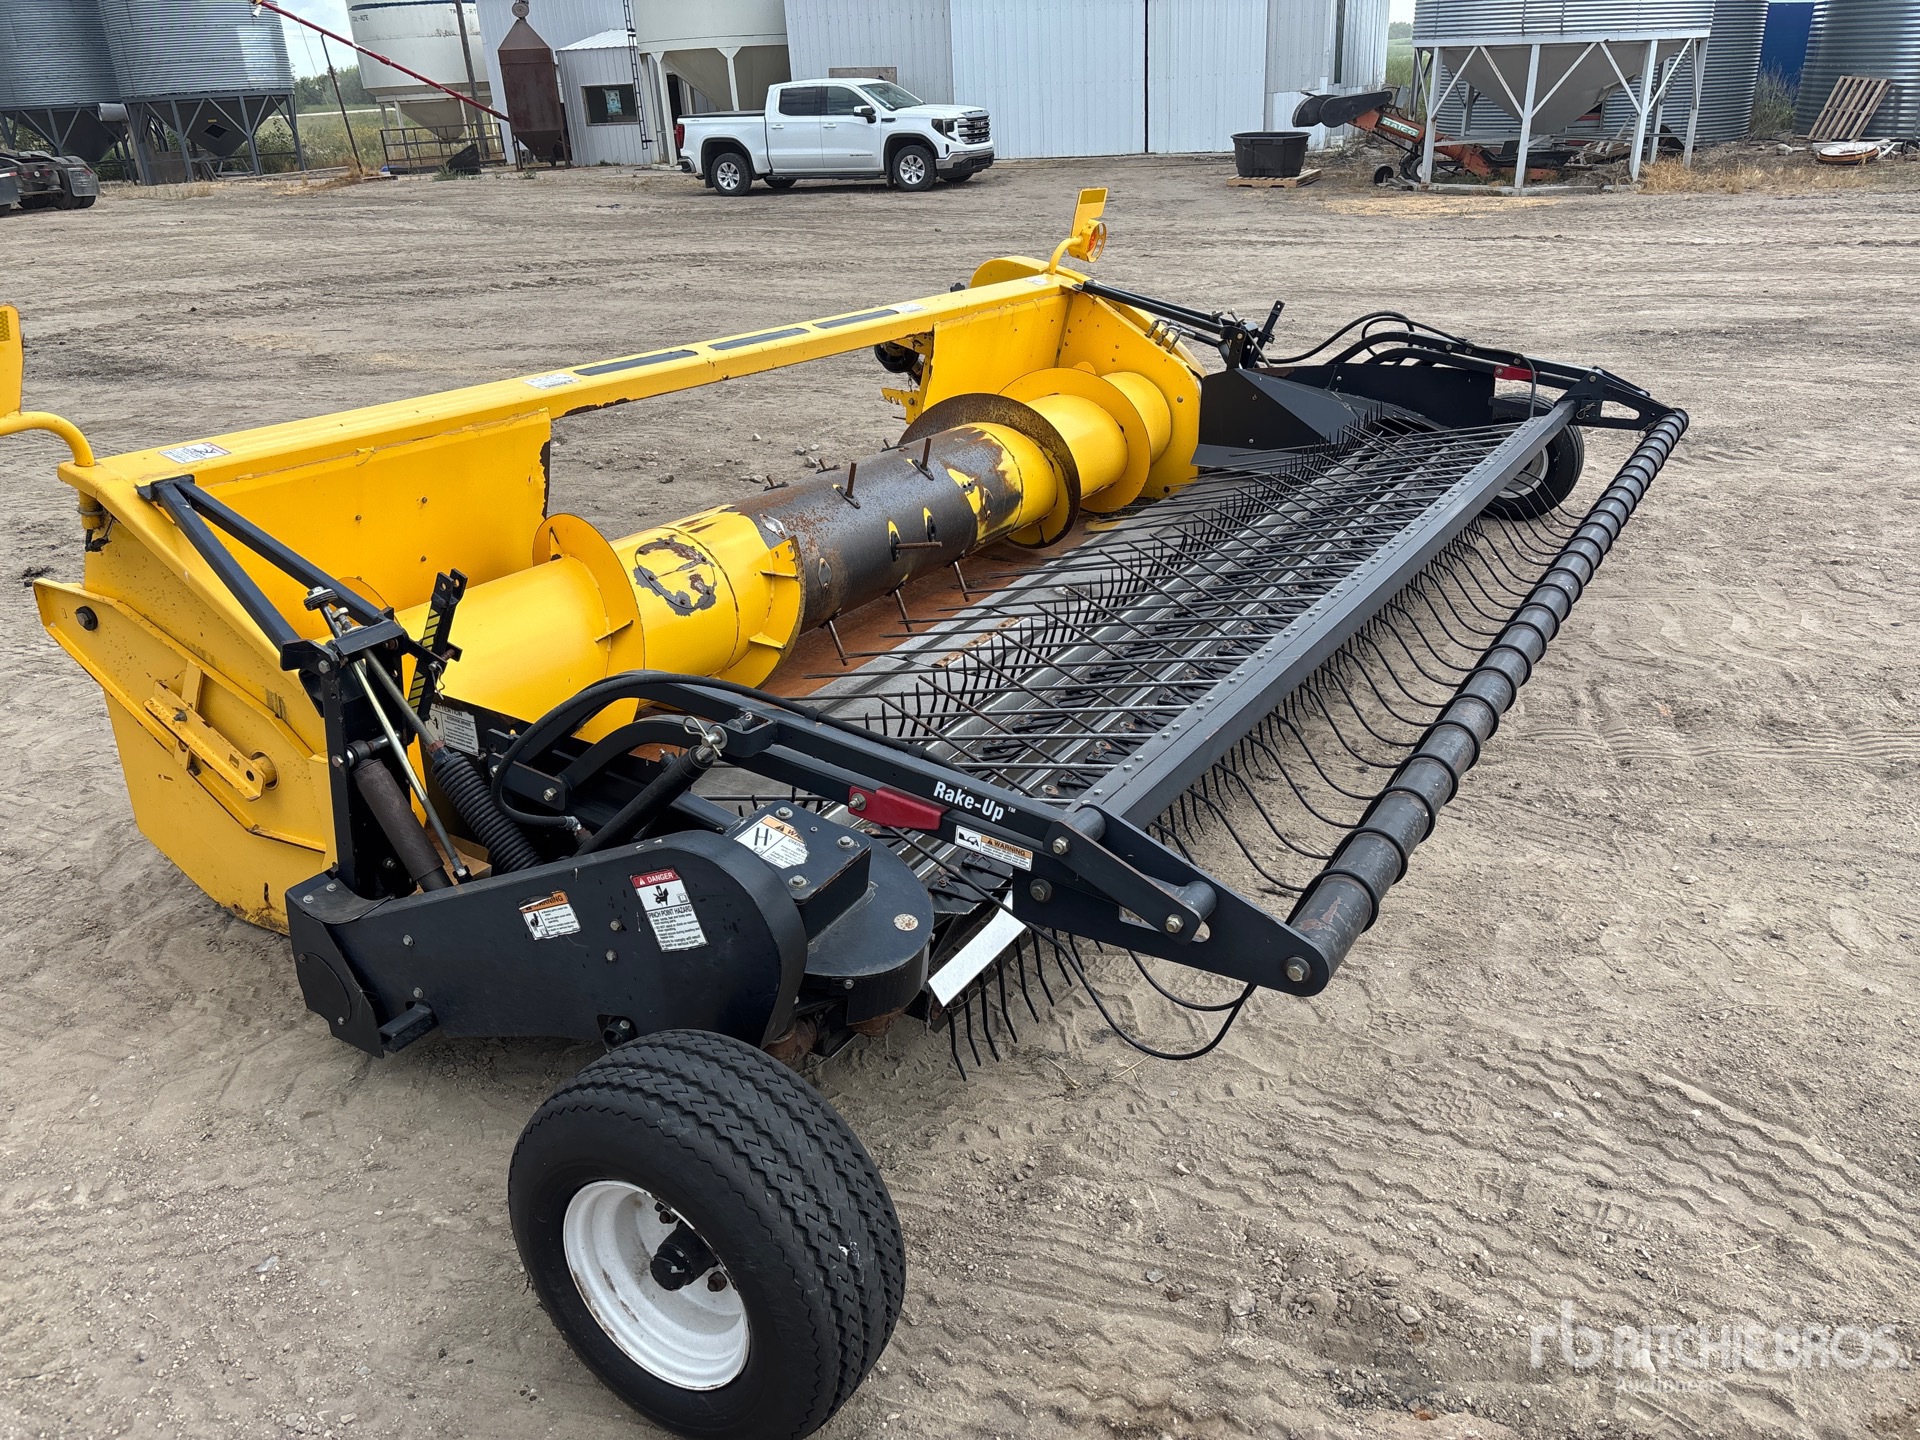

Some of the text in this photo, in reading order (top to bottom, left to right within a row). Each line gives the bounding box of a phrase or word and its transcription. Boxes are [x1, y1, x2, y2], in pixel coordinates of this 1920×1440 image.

[933, 781, 1004, 822] Rake-Up
[994, 840, 1026, 856] WARNING
[647, 872, 674, 883] DANGER
[661, 908, 674, 916] POINT
[674, 905, 693, 914] HAZARD
